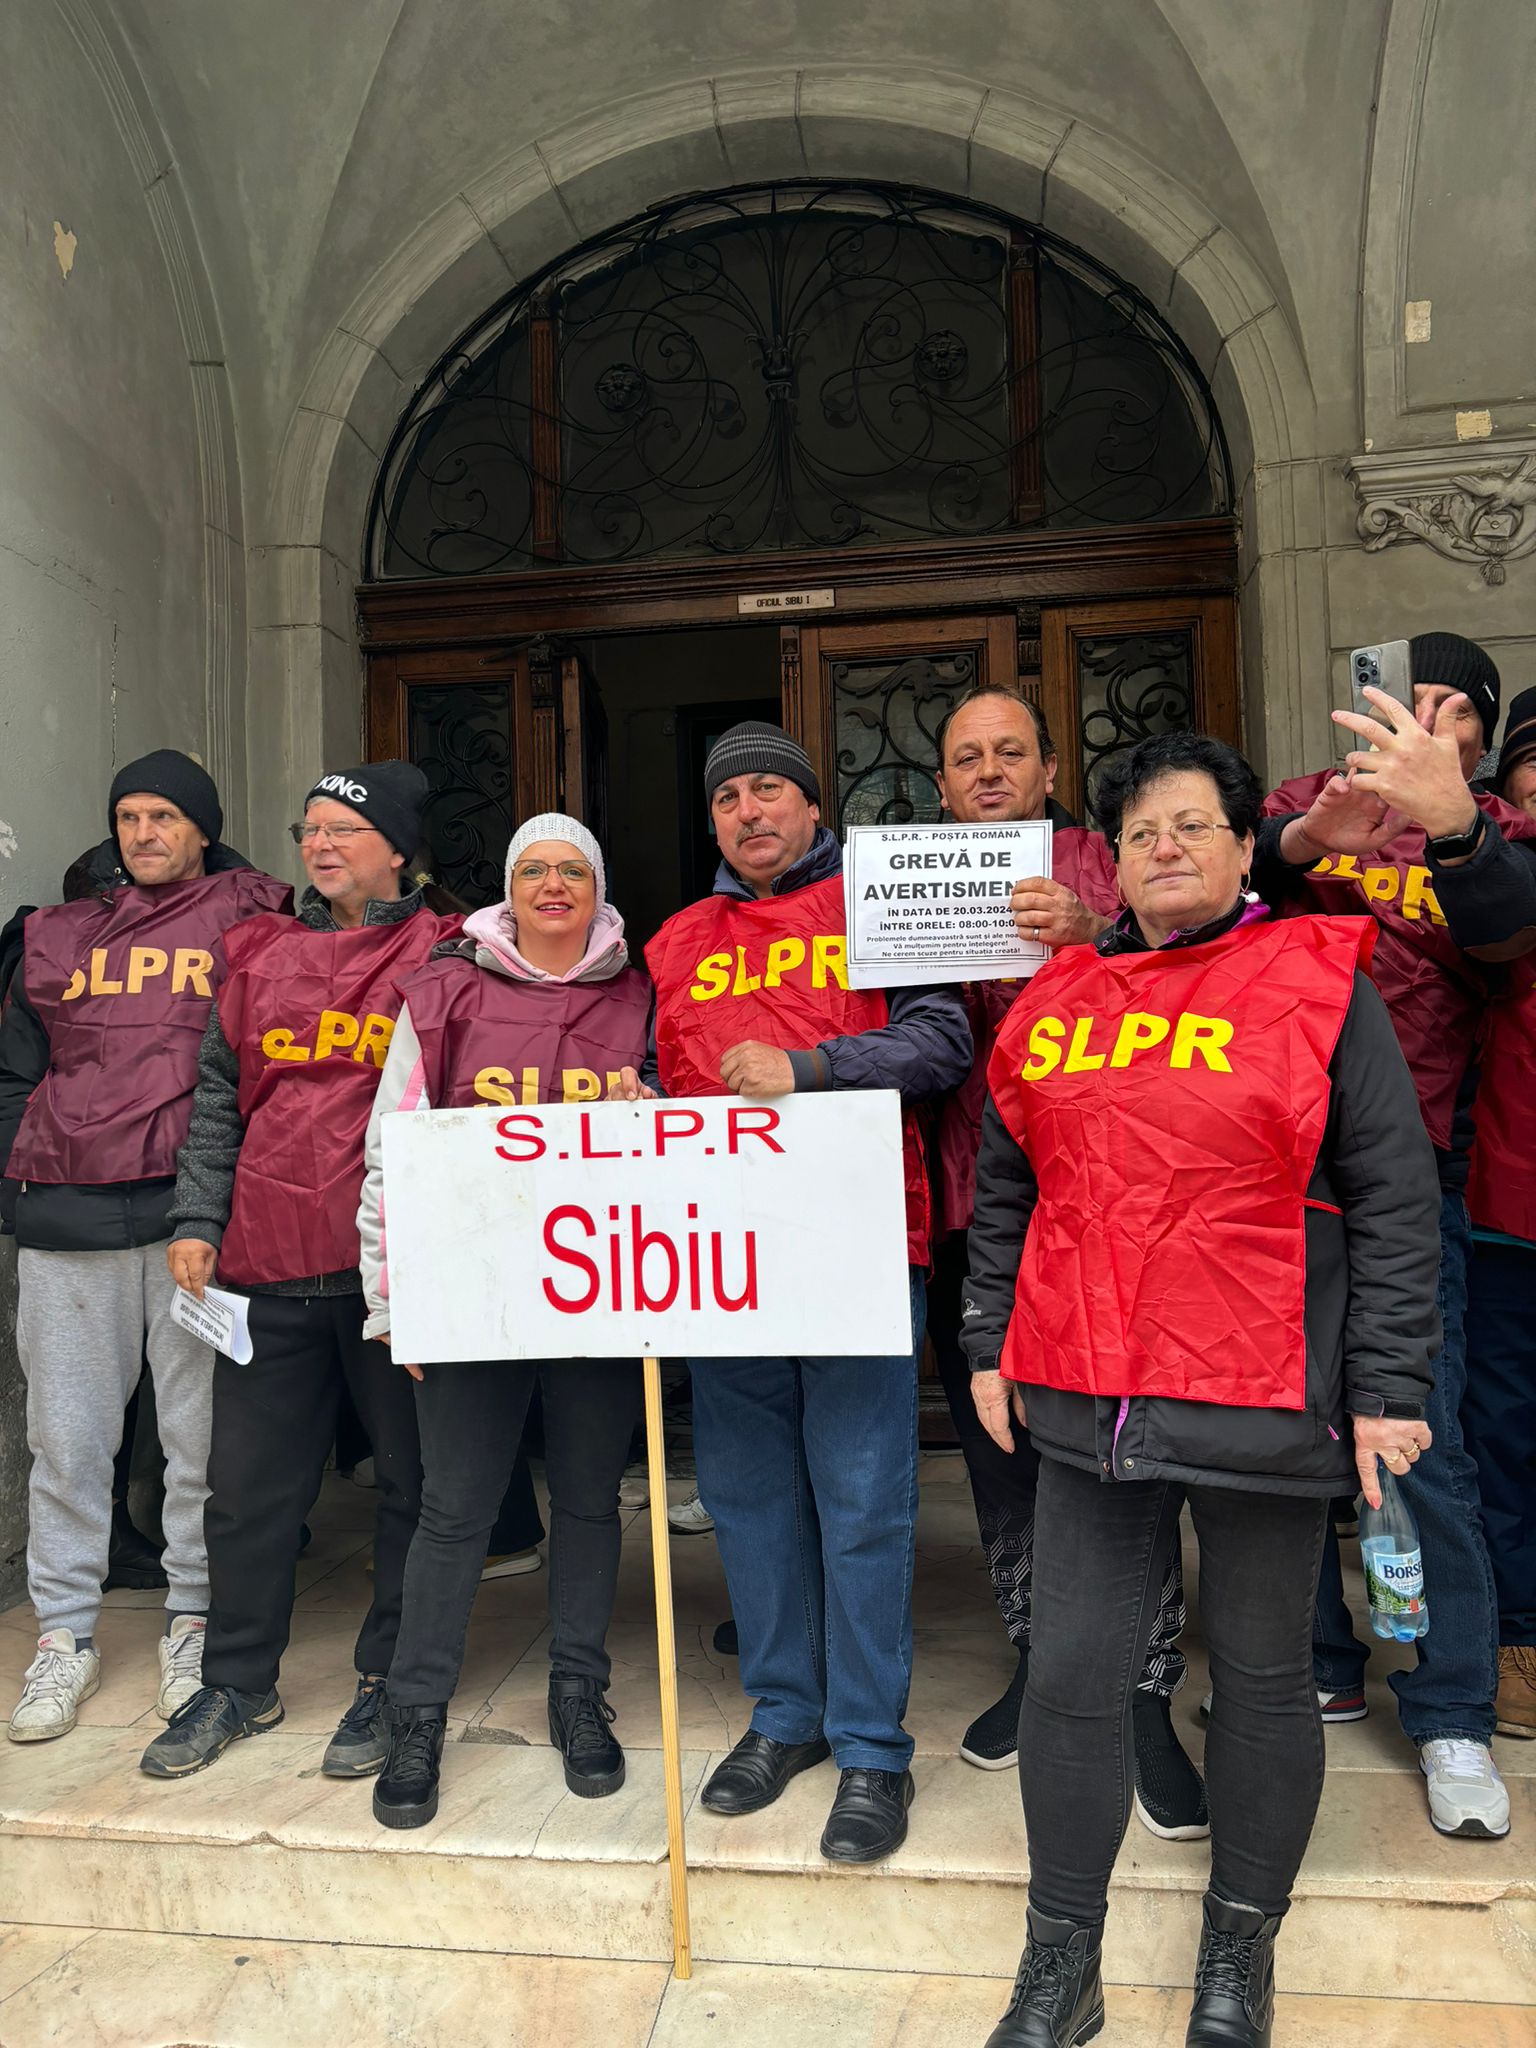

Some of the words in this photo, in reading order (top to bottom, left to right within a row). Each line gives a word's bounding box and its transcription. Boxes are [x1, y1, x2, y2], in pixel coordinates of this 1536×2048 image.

[756, 598, 782, 607] OFICIUL
[785, 596, 803, 606] SIBIU
[314, 775, 368, 802] KING
[881, 833, 922, 841] S.L.P.R.
[889, 848, 972, 869] GREVĂ
[980, 852, 1011, 867] DE
[863, 881, 1017, 900] AVERTISMEN
[1311, 854, 1448, 927] LPR
[887, 907, 899, 917] ÎN
[903, 908, 932, 916] DATA
[936, 907, 950, 915] DE
[953, 906, 1013, 915] 20.03.2024
[879, 921, 912, 931] ÎNTRE
[916, 921, 956, 929] ORELE:
[959, 919, 1015, 928] 08:00-10:0
[942, 941, 967, 949] pentru
[690, 935, 851, 1001] SLPR
[1021, 1012, 1235, 1081] SLPR
[495, 1107, 787, 1162] S.L.P.R
[542, 1203, 758, 1314] Sibiu
[1383, 1560, 1422, 1579] BORSE
